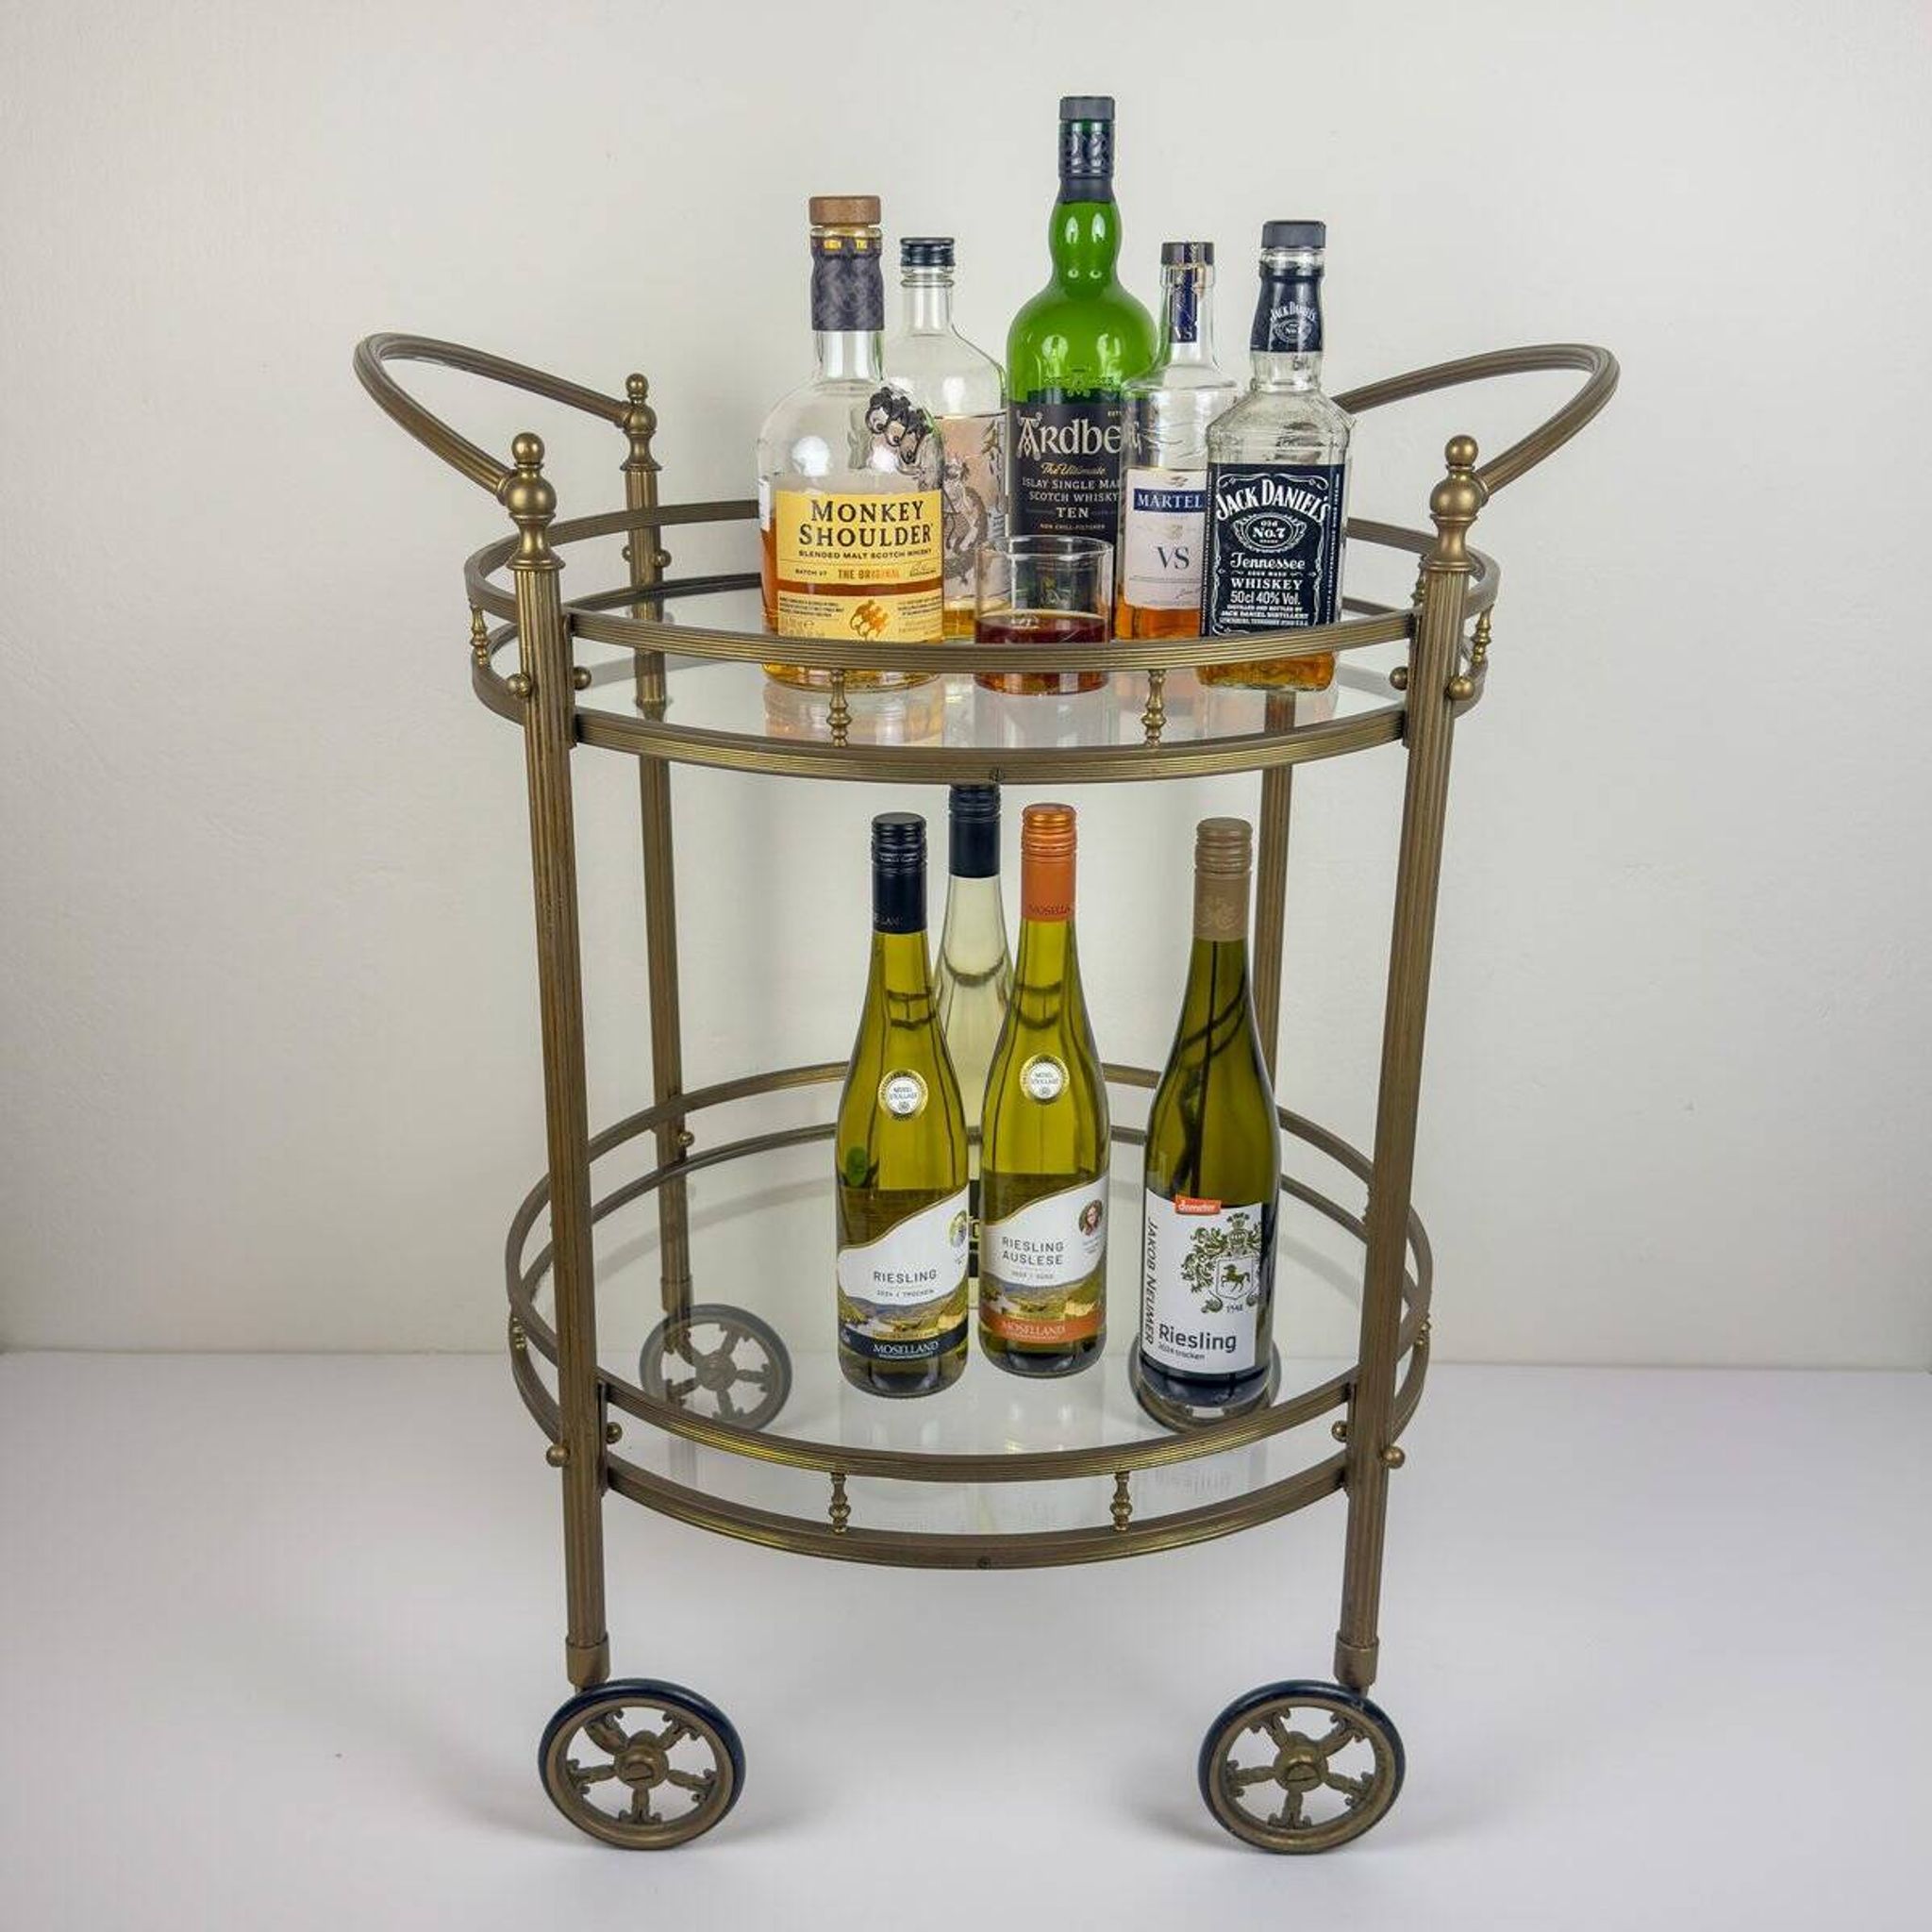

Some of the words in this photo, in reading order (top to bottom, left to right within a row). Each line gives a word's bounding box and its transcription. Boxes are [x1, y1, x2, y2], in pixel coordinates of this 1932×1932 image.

[1016, 409, 1122, 461] Ardbe
[1022, 477, 1048, 489] ISLAY
[1052, 479, 1095, 491] SINGLE
[1028, 491, 1069, 502] SCOTCH
[1074, 491, 1119, 503] WHISKY
[1137, 493, 1203, 508] MARTEL
[1215, 485, 1259, 521] JACK
[1261, 478, 1331, 524] DANIEL'S
[811, 500, 924, 523] MONKEY
[1056, 507, 1090, 518] TEN
[799, 524, 931, 547] SHOULDER
[798, 550, 841, 559] BLENDED
[842, 551, 868, 559] MALT
[871, 550, 906, 559] SCOTCH
[1157, 545, 1190, 570] VS
[1230, 553, 1306, 570] Tennessee
[838, 569, 855, 579] THE
[1230, 577, 1303, 591] WHISKEY
[1230, 590, 1255, 604] 50cl
[1256, 591, 1280, 605] 40%
[1282, 591, 1301, 605] Vol.
[1002, 1236, 1064, 1252] RIESLING
[1146, 1216, 1159, 1271] JAKOB
[1003, 1250, 1063, 1265] AUSLESE
[874, 1269, 937, 1284] RIESLING
[1158, 1323, 1237, 1354] Riesling
[873, 1341, 939, 1355] MOSELLAND
